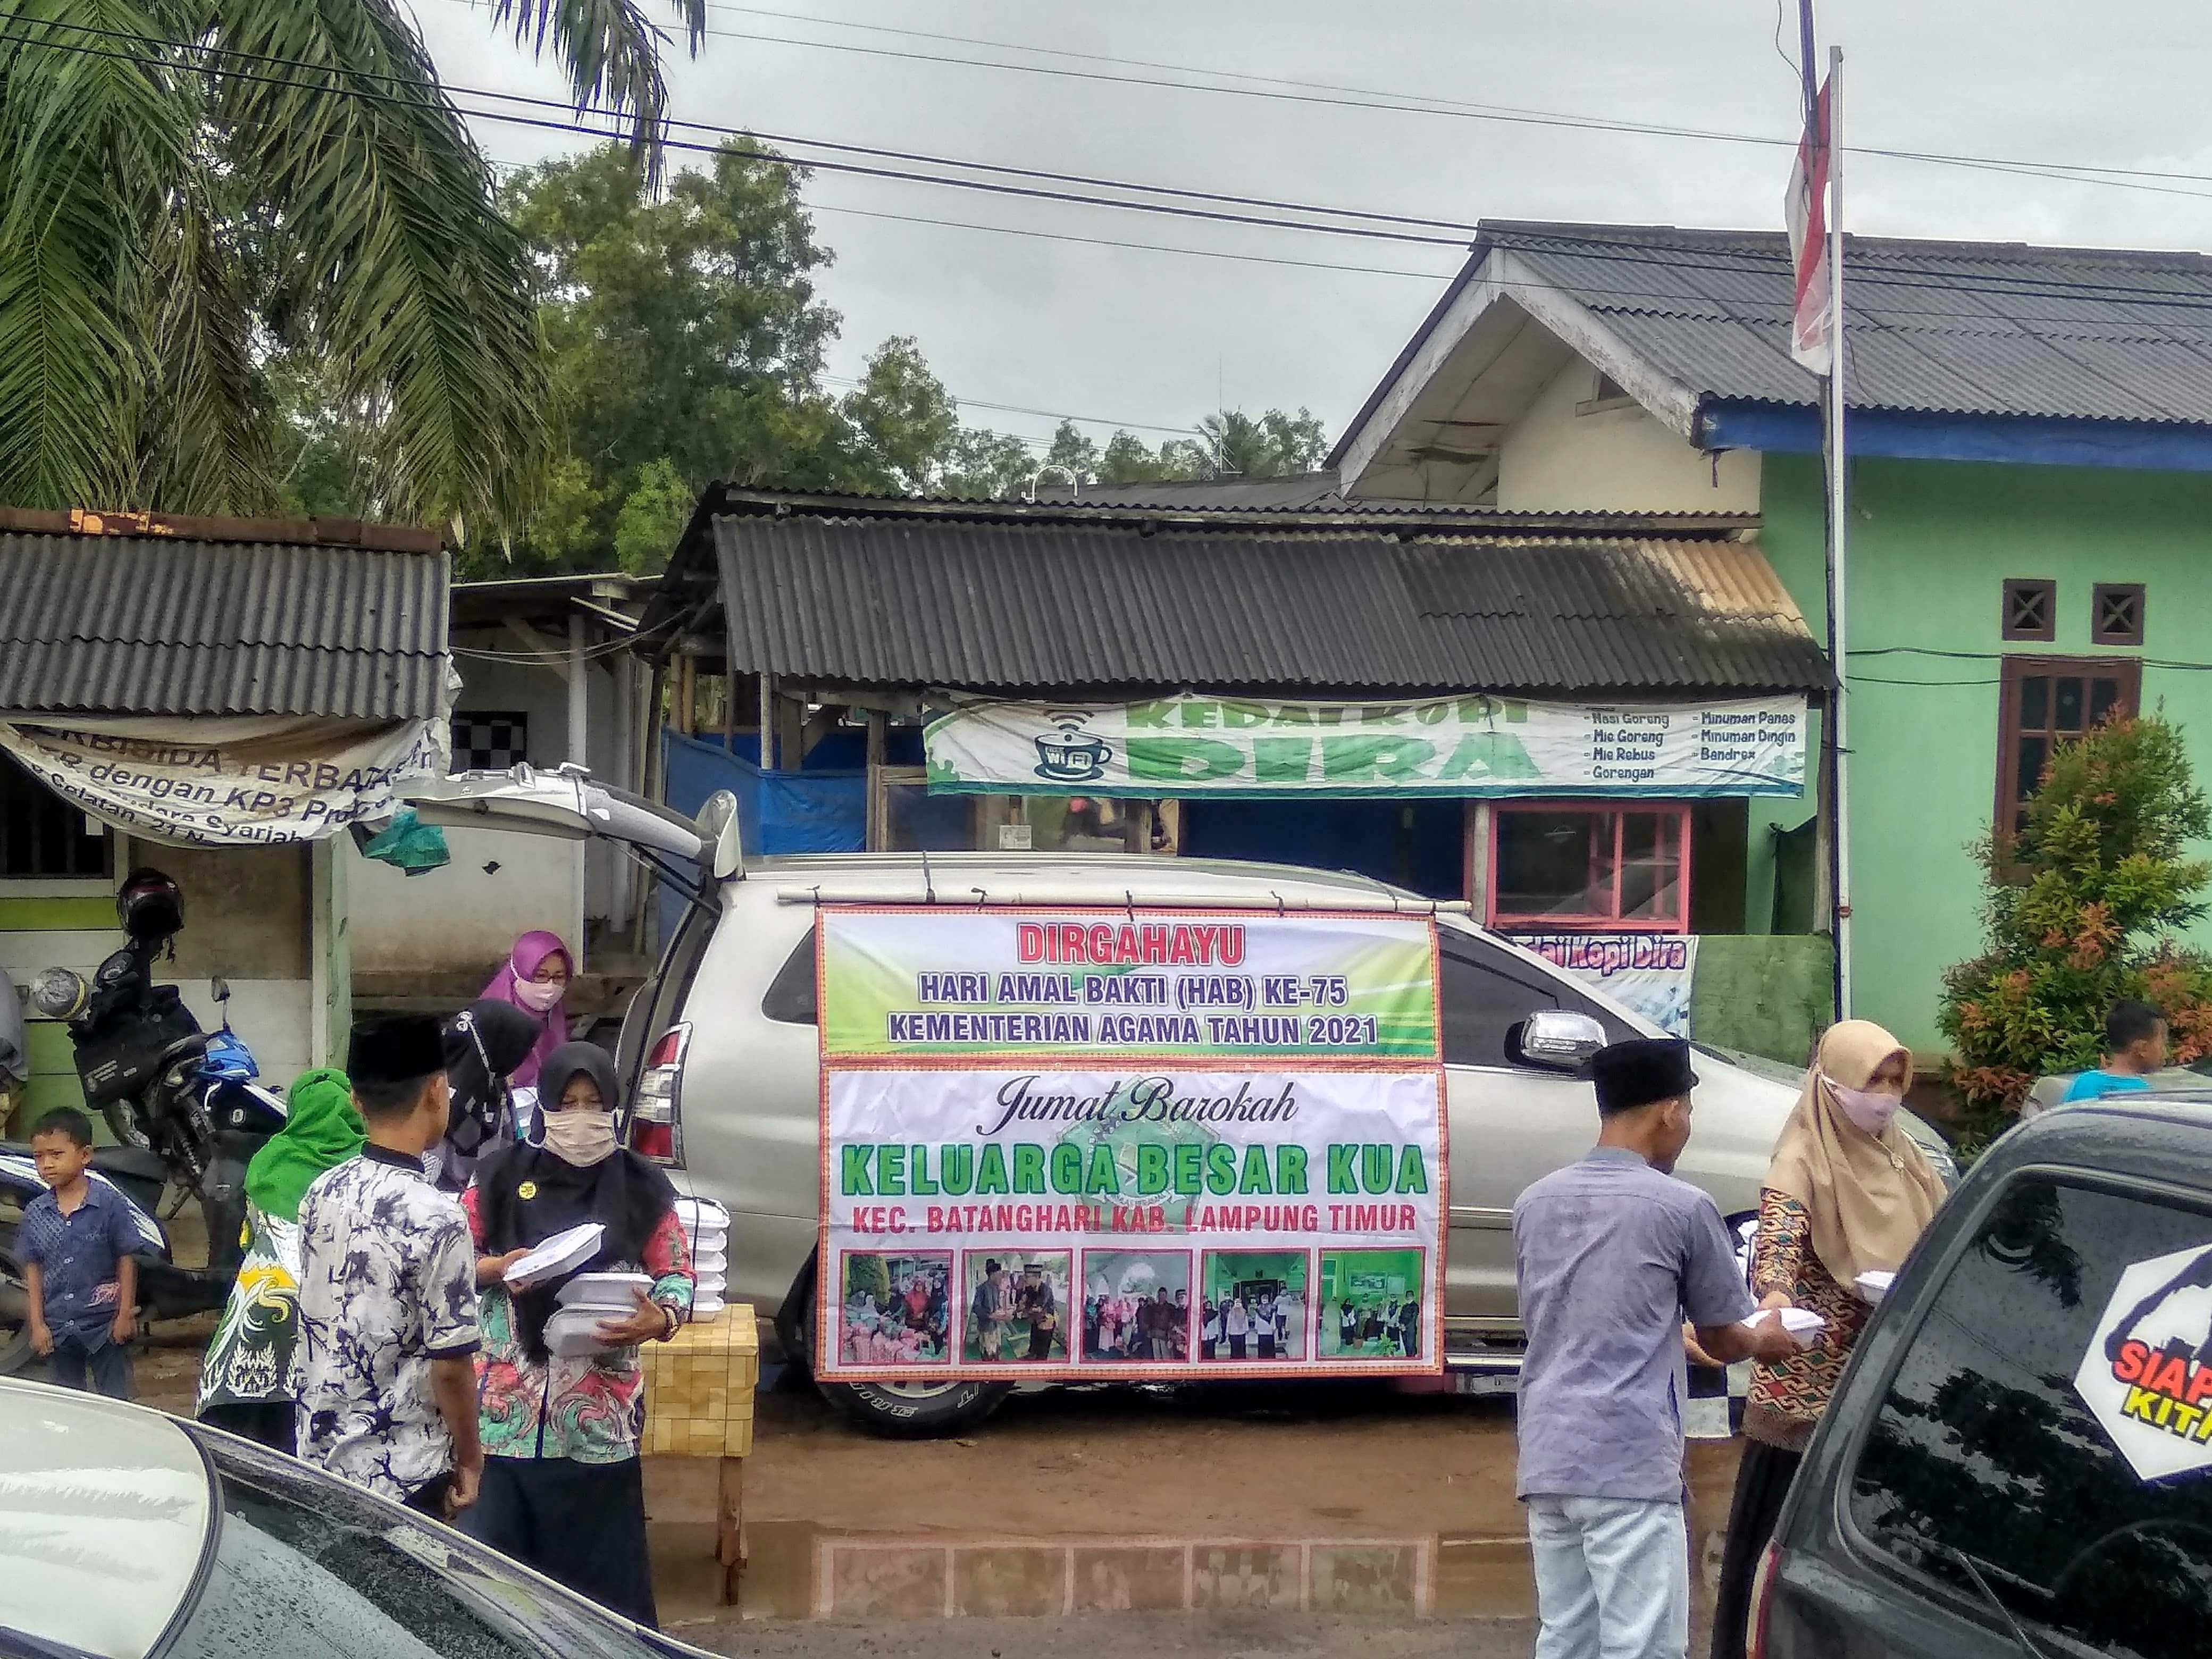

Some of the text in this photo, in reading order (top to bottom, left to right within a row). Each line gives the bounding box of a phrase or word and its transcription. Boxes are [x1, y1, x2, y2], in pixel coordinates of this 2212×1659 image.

[1127, 696, 1528, 728] KEDAI KOPI
[1593, 714, 1670, 728] Nasi Goreng
[1702, 711, 1796, 725] Minuman Panas
[1593, 730, 1664, 747] Mie Goreng
[1593, 748, 1655, 760] Mie Rebus
[1700, 747, 1756, 760] Bandrex
[1701, 730, 1796, 747] Minuman Dingin
[1127, 732, 1541, 784] DIRA
[1592, 765, 1655, 783] Gorengan
[90, 763, 215, 802] dengan
[223, 786, 295, 817] KP3
[1018, 923, 1246, 967] DIRGAHAYU
[1569, 936, 1630, 977] Kopi
[1632, 936, 1687, 970] Dira
[918, 973, 1348, 1012] HARI AMAL BAKTI (HAB) KE-75
[887, 1012, 1378, 1046] KEMENTERIAN AGAMA TAHUN 2021
[975, 1075, 1300, 1136] Jumat Barokah
[841, 1142, 1428, 1196] KELUARGA BESAR KUA
[852, 1204, 1417, 1234] KEC. BATANGHARI KAB. LAMPUNG TIMUR
[2113, 1340, 2212, 1405] SIAP
